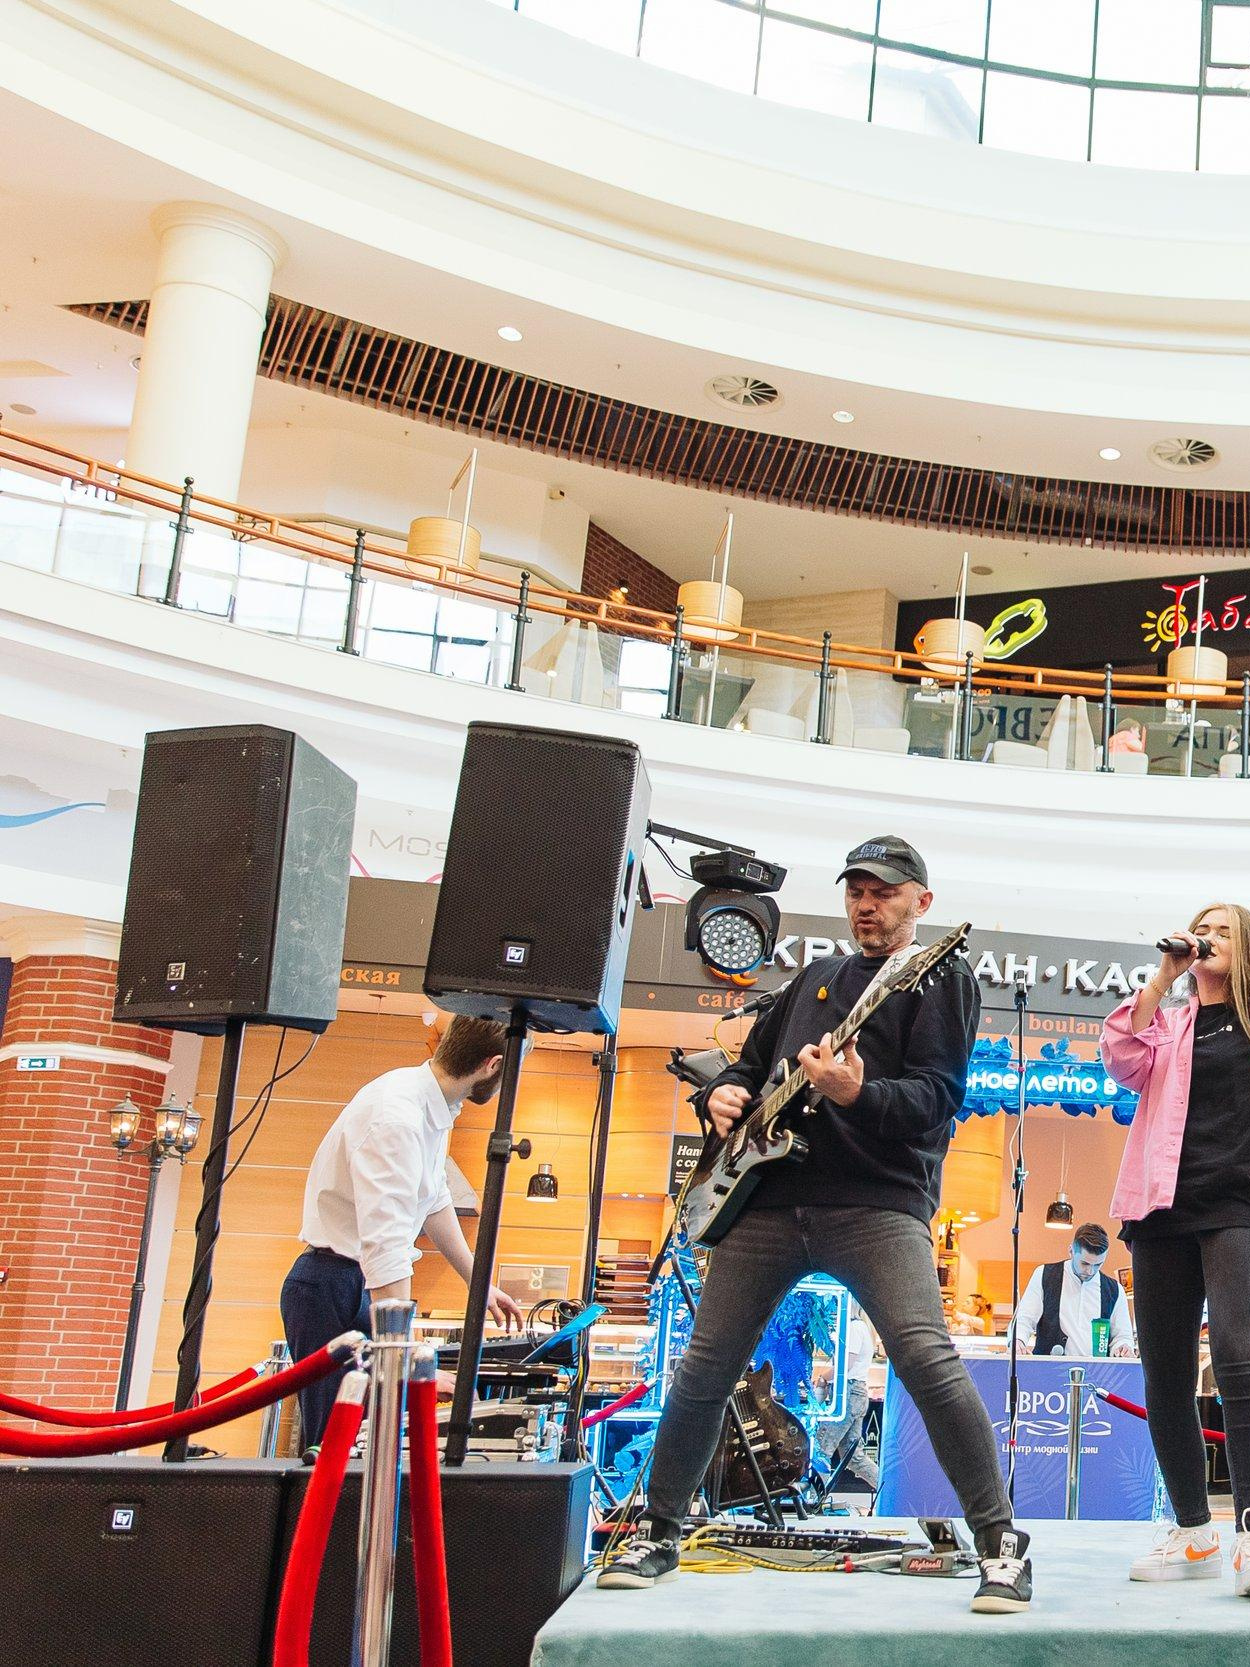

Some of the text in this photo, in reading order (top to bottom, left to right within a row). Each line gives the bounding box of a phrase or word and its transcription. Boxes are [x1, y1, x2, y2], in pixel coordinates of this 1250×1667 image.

[369, 828, 449, 861] MOS
[341, 967, 400, 985] ская
[697, 990, 745, 1008] café
[1029, 1014, 1101, 1035] boulan
[1026, 1074, 1098, 1094] лето
[684, 1159, 698, 1168] со
[1005, 1391, 1100, 1415] ВРОА
[1002, 1443, 1032, 1456] Цнтр
[1033, 1445, 1069, 1456] модной
